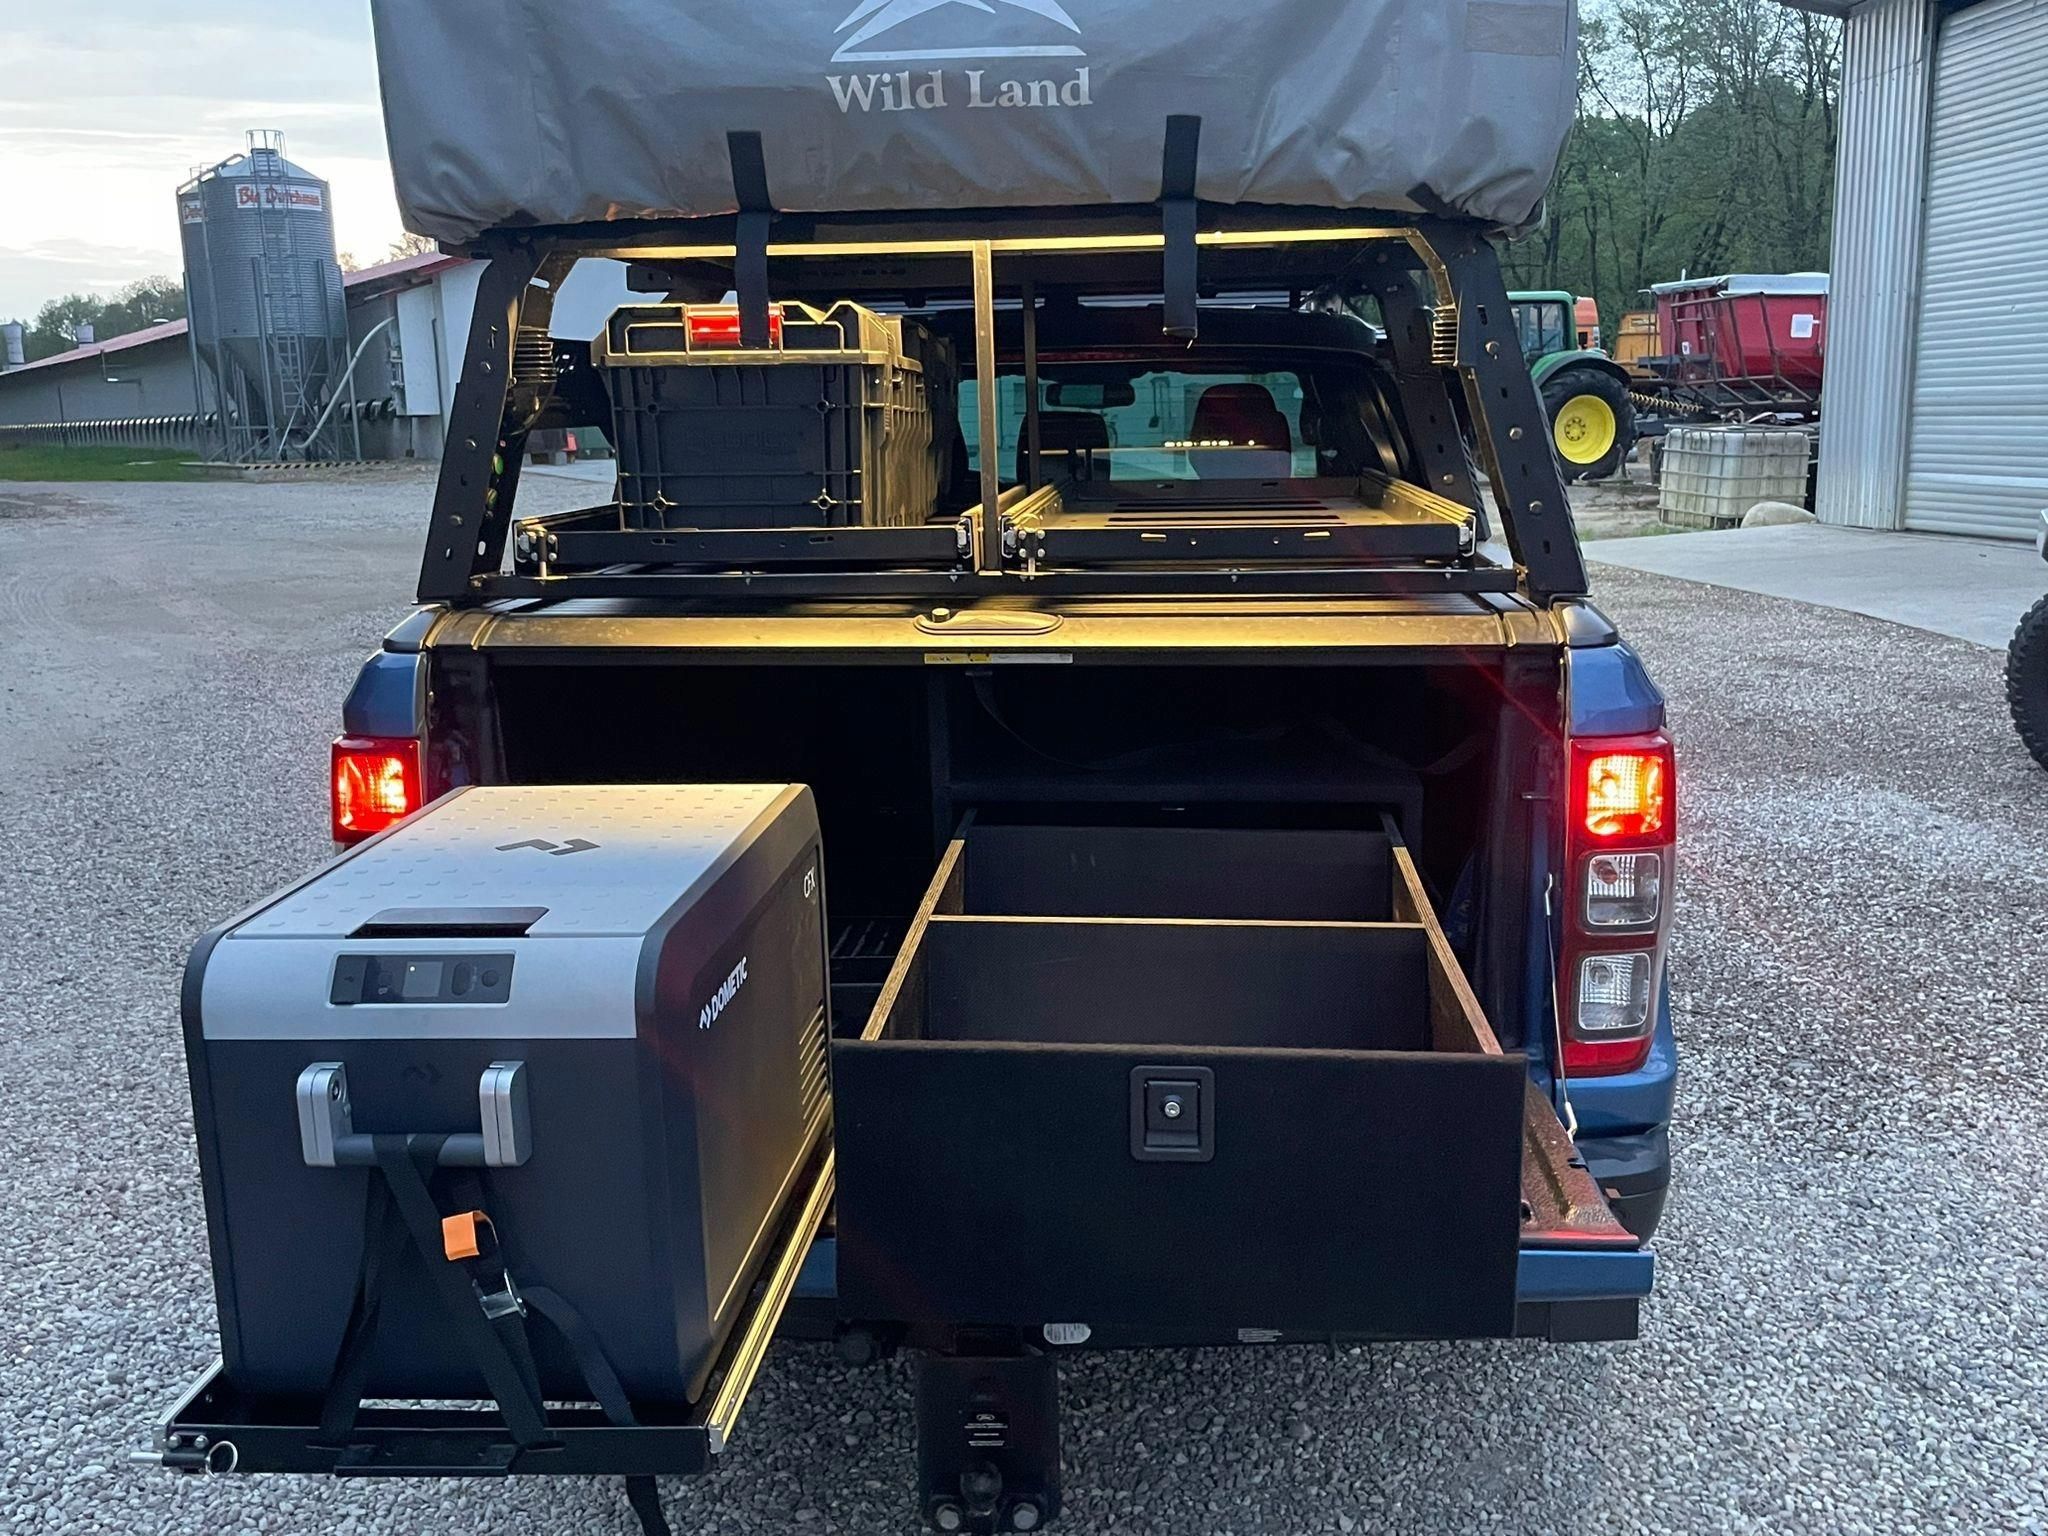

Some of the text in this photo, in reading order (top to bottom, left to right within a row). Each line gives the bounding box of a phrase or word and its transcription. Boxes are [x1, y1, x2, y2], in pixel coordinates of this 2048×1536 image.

[825, 66, 1094, 113] Wild Land
[711, 956, 748, 1022] DOMETIC
